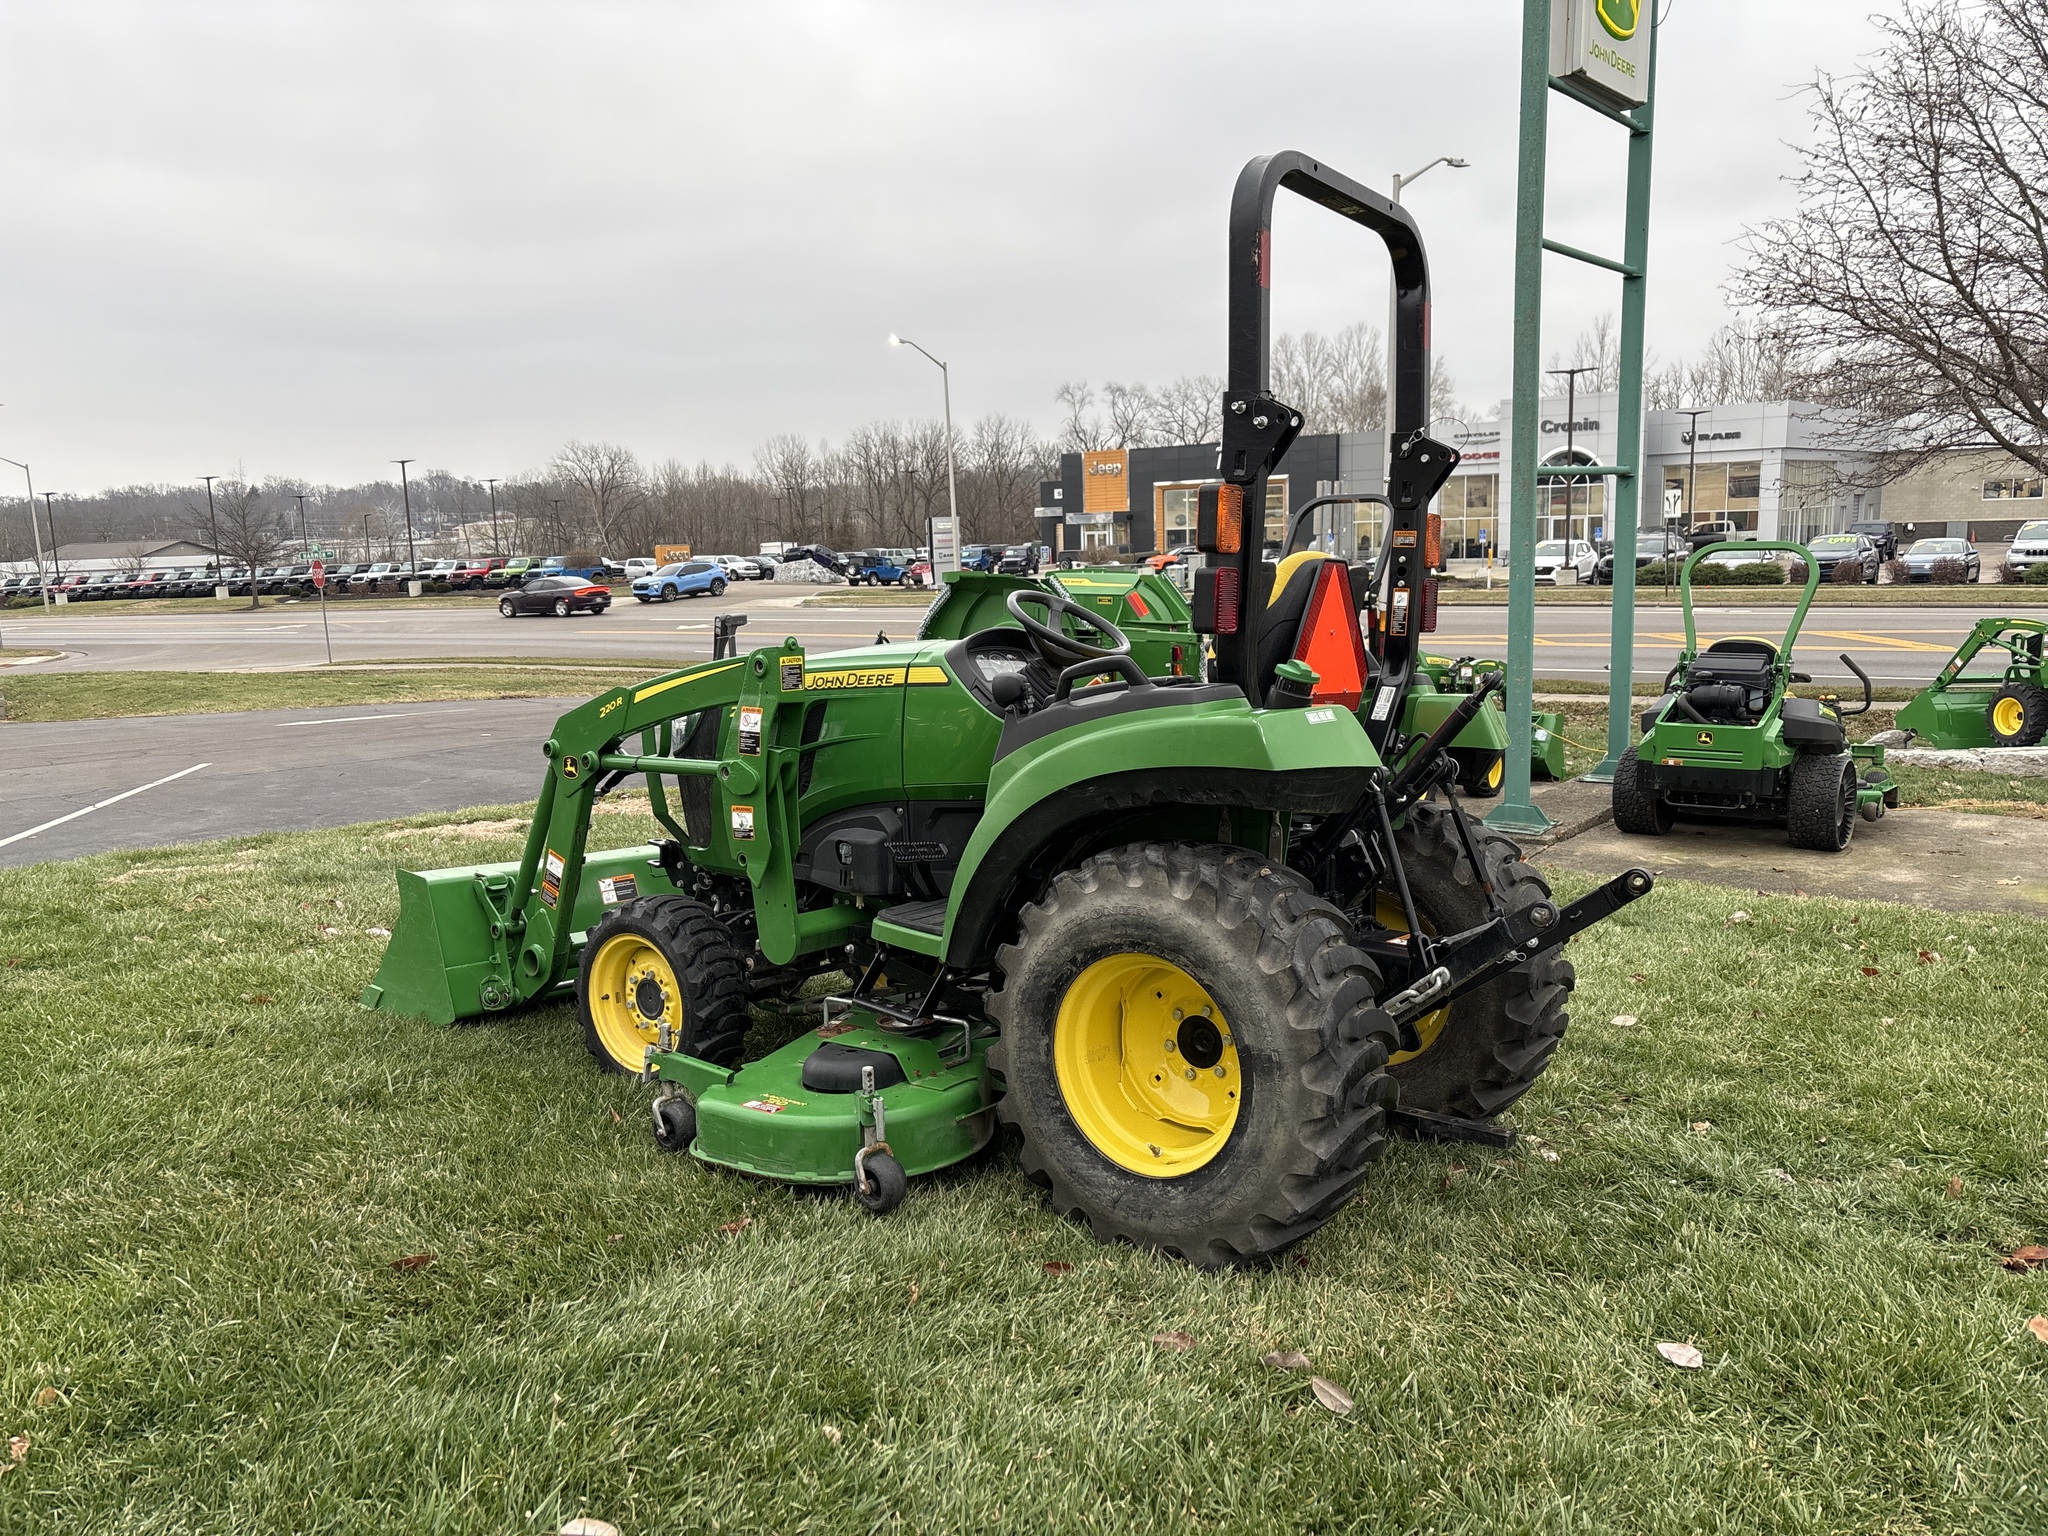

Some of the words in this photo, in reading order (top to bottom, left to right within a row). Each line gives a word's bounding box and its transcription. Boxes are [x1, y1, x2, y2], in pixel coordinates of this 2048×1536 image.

[1589, 39, 1610, 65] JOHN
[1610, 50, 1636, 79] DEERE
[1541, 418, 1600, 434] Cronin
[1697, 432, 1742, 441] RAM
[1088, 461, 1123, 477] Jeep
[662, 548, 690, 562] Jeep
[312, 568, 324, 579] STOP
[807, 675, 845, 688] JOHN
[846, 673, 895, 686] DEERE
